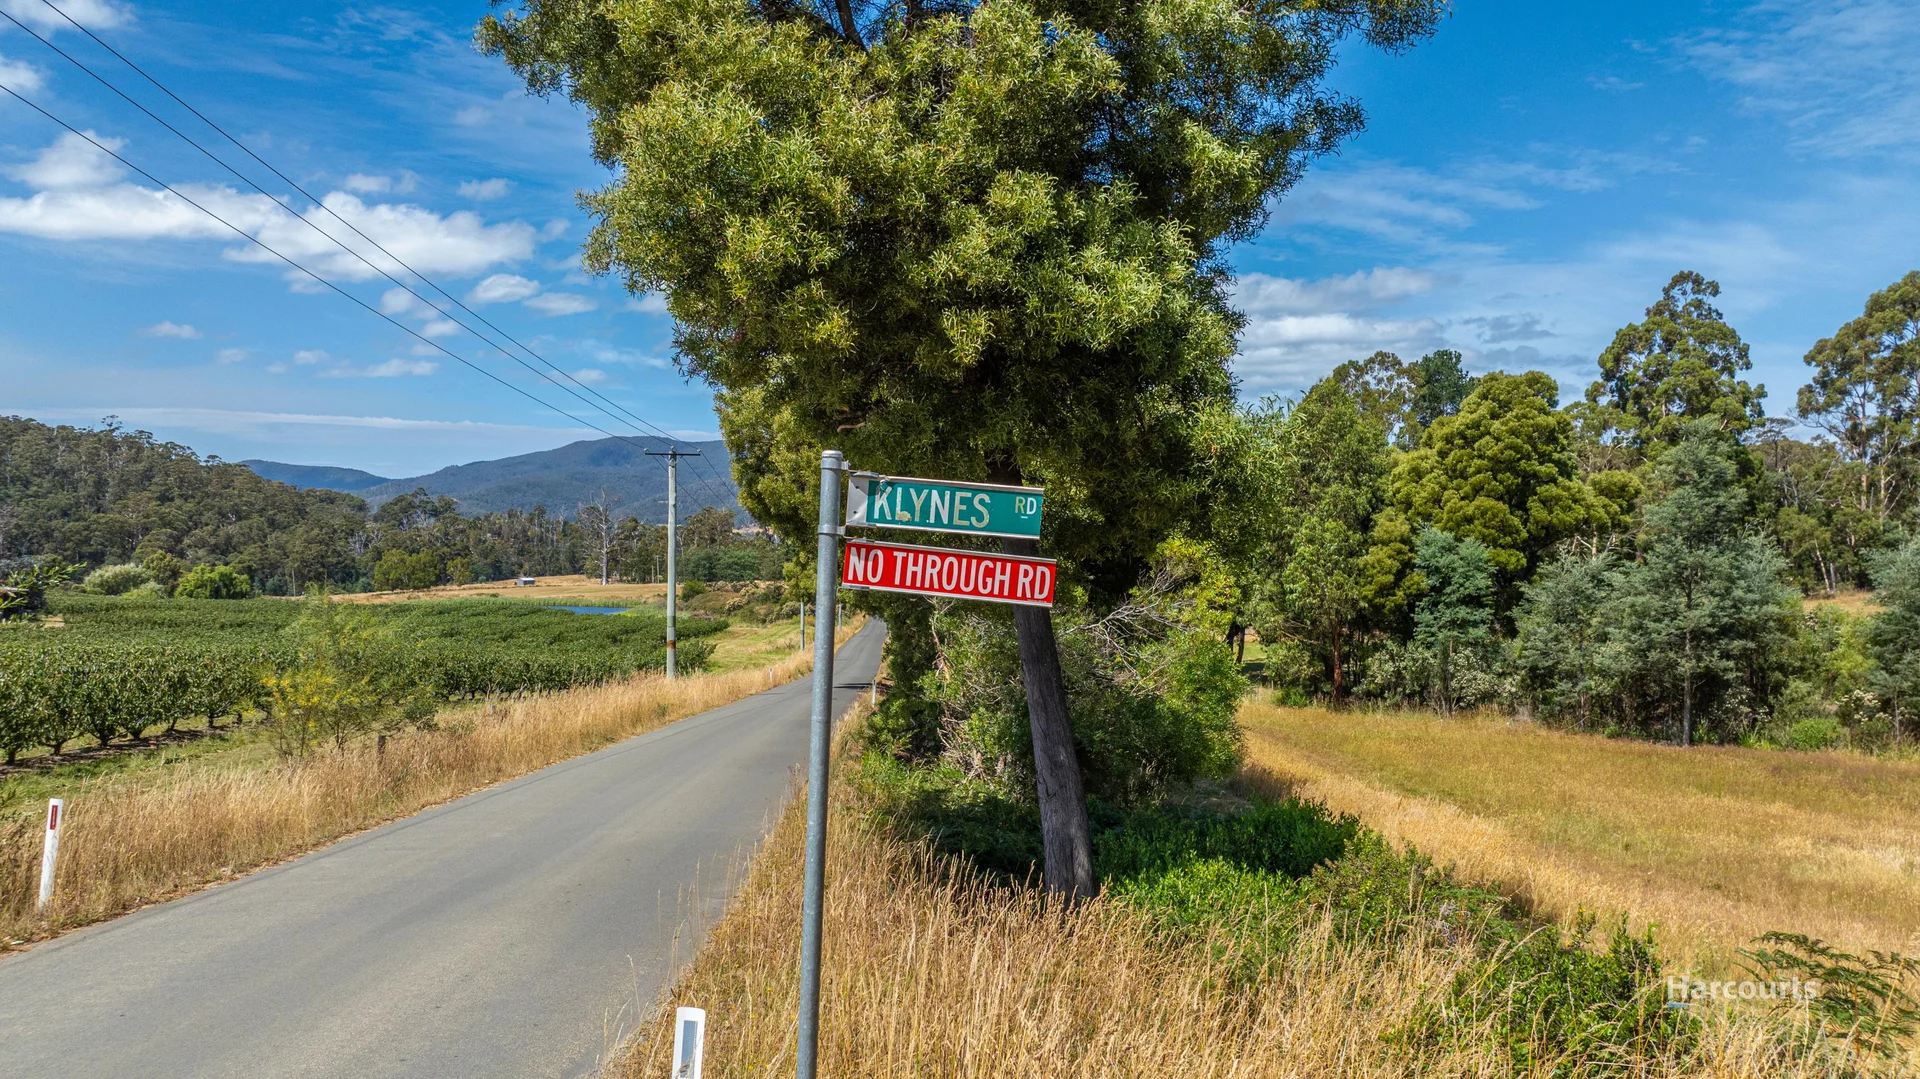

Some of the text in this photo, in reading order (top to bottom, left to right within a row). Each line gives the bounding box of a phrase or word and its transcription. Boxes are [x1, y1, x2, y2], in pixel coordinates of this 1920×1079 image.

[873, 486, 1037, 528] KLYNES RD
[847, 546, 1051, 599] NO THROUGH RD
